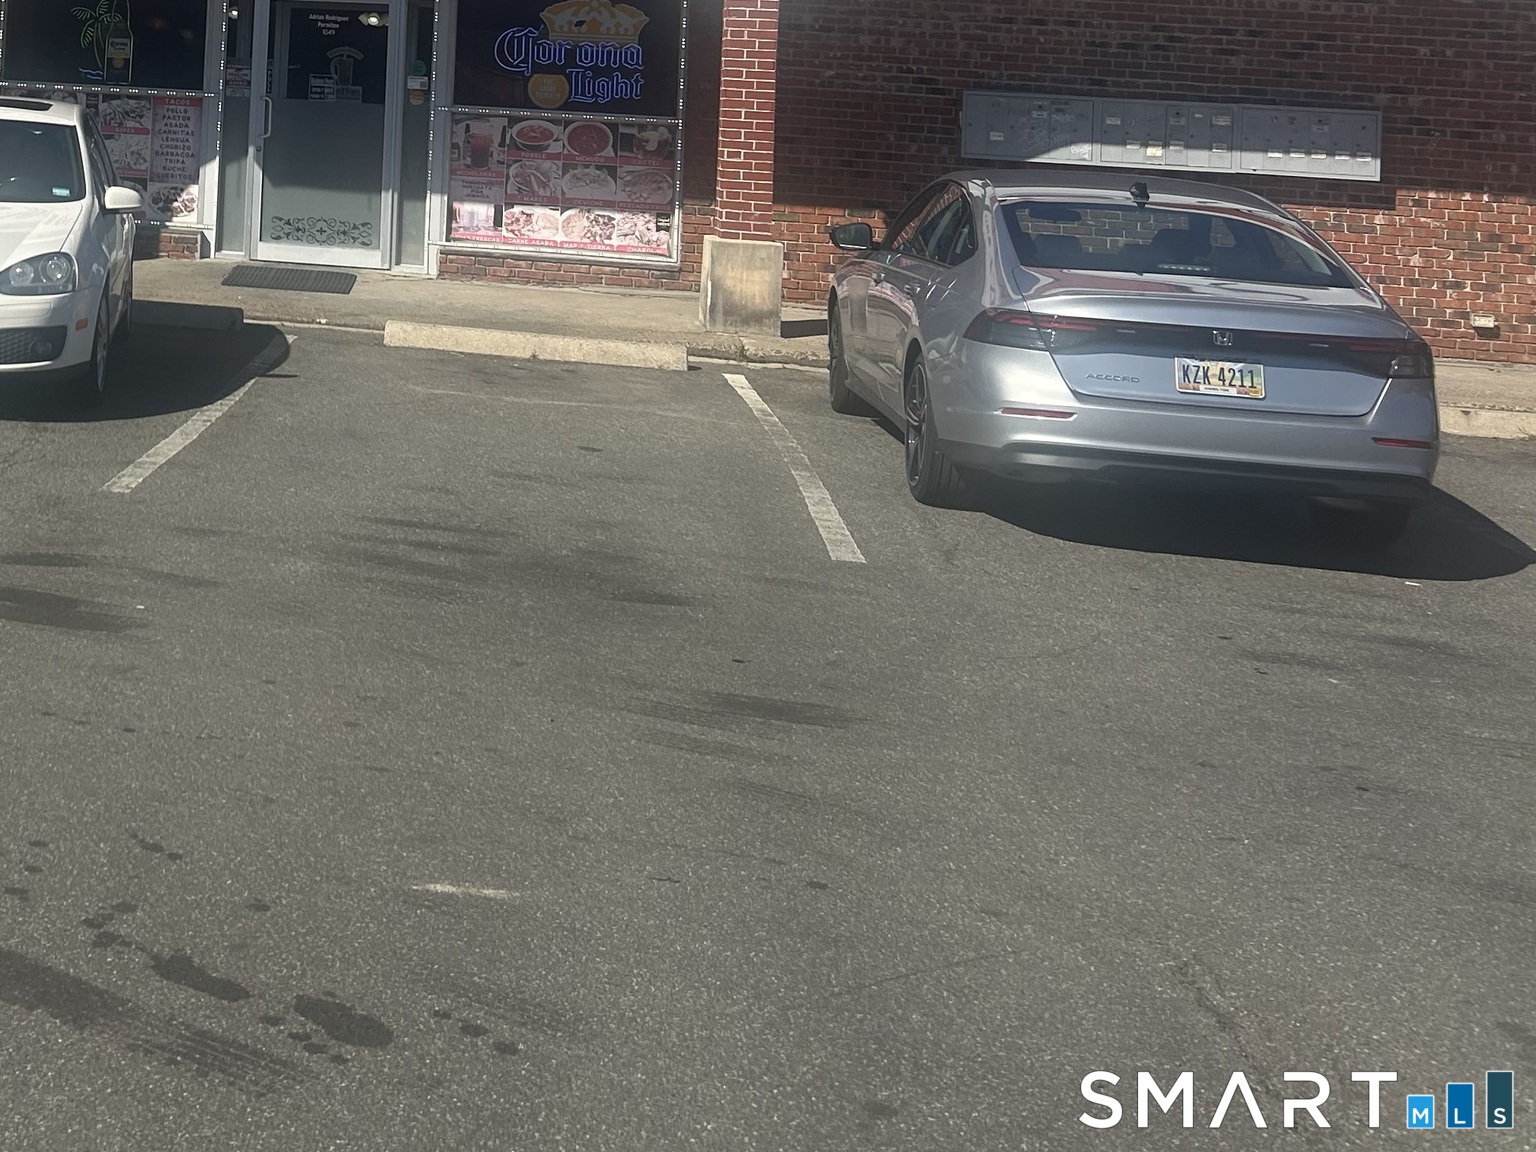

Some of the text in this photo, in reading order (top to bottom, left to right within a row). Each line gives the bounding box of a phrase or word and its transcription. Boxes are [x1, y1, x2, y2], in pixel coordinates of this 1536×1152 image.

[494, 26, 645, 77] Corona
[566, 68, 645, 103] Light
[165, 98, 191, 106] TACOS
[1085, 373, 1140, 383] ACCORD
[1182, 364, 1257, 389] KZK 4211
